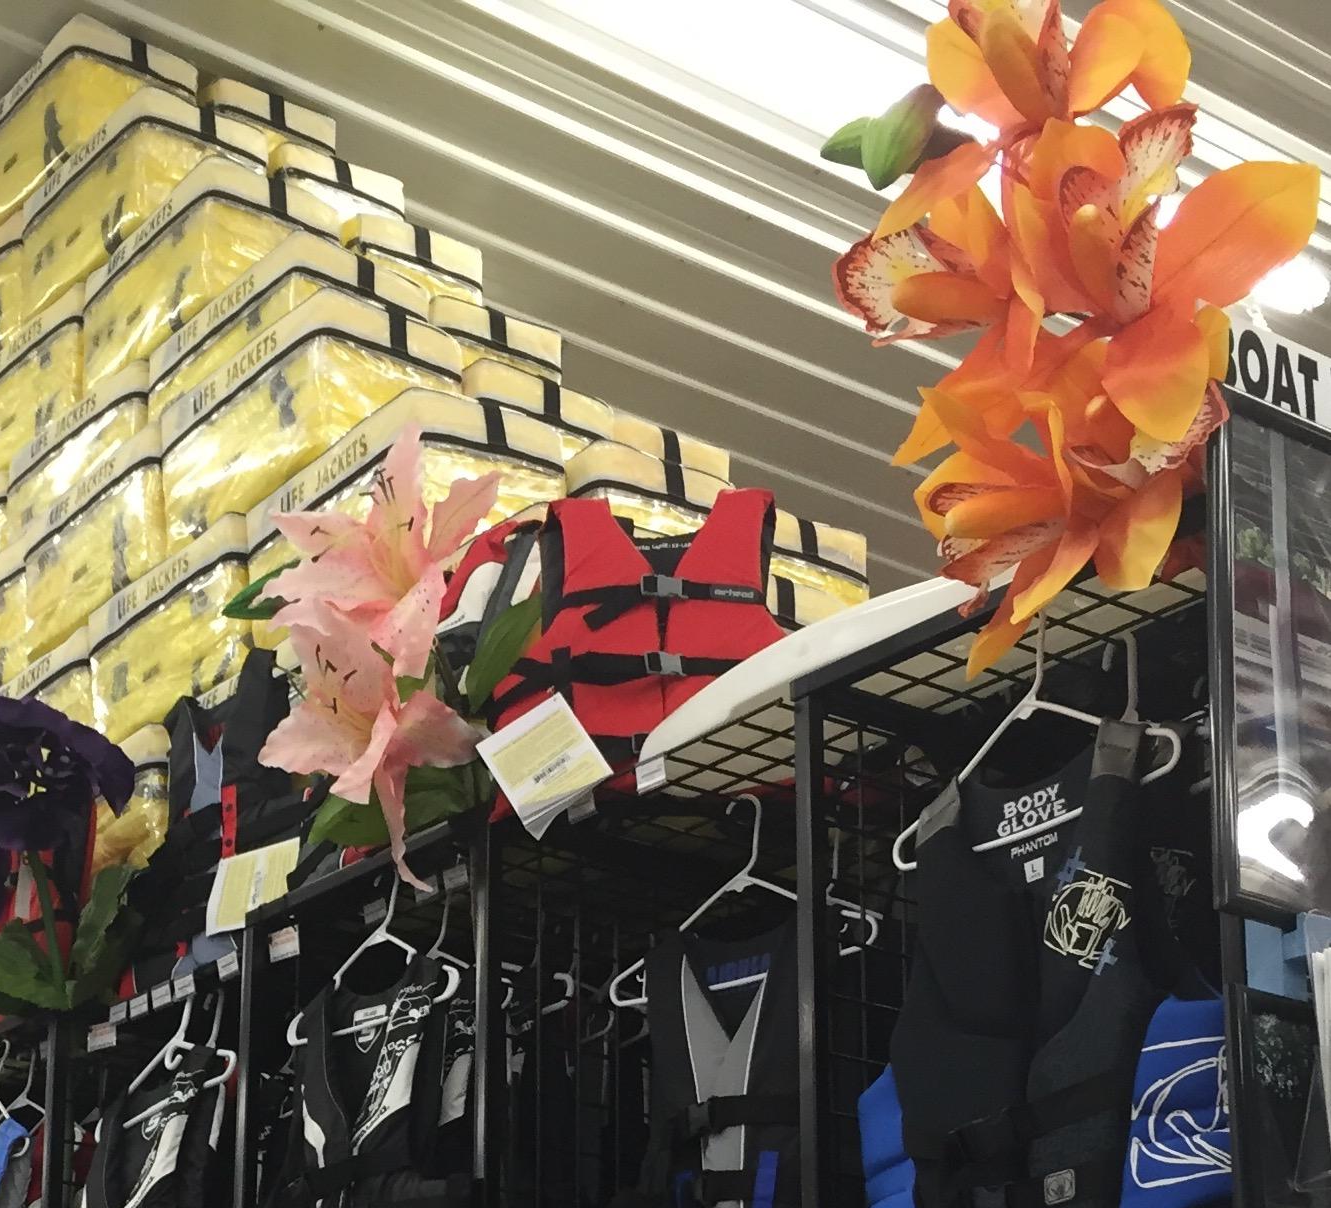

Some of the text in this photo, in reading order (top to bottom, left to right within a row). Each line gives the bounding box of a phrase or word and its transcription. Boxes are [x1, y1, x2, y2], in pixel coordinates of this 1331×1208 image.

[207, 275, 254, 326] JACKETS
[193, 333, 277, 414] LIFE JACKETS
[280, 435, 368, 512] LIFE JACKETS
[117, 558, 189, 620] LIFE JACKETS
[997, 798, 1067, 837] GLOVE
[1003, 783, 1059, 819] BODY
[1010, 831, 1058, 859] PHANTOM
